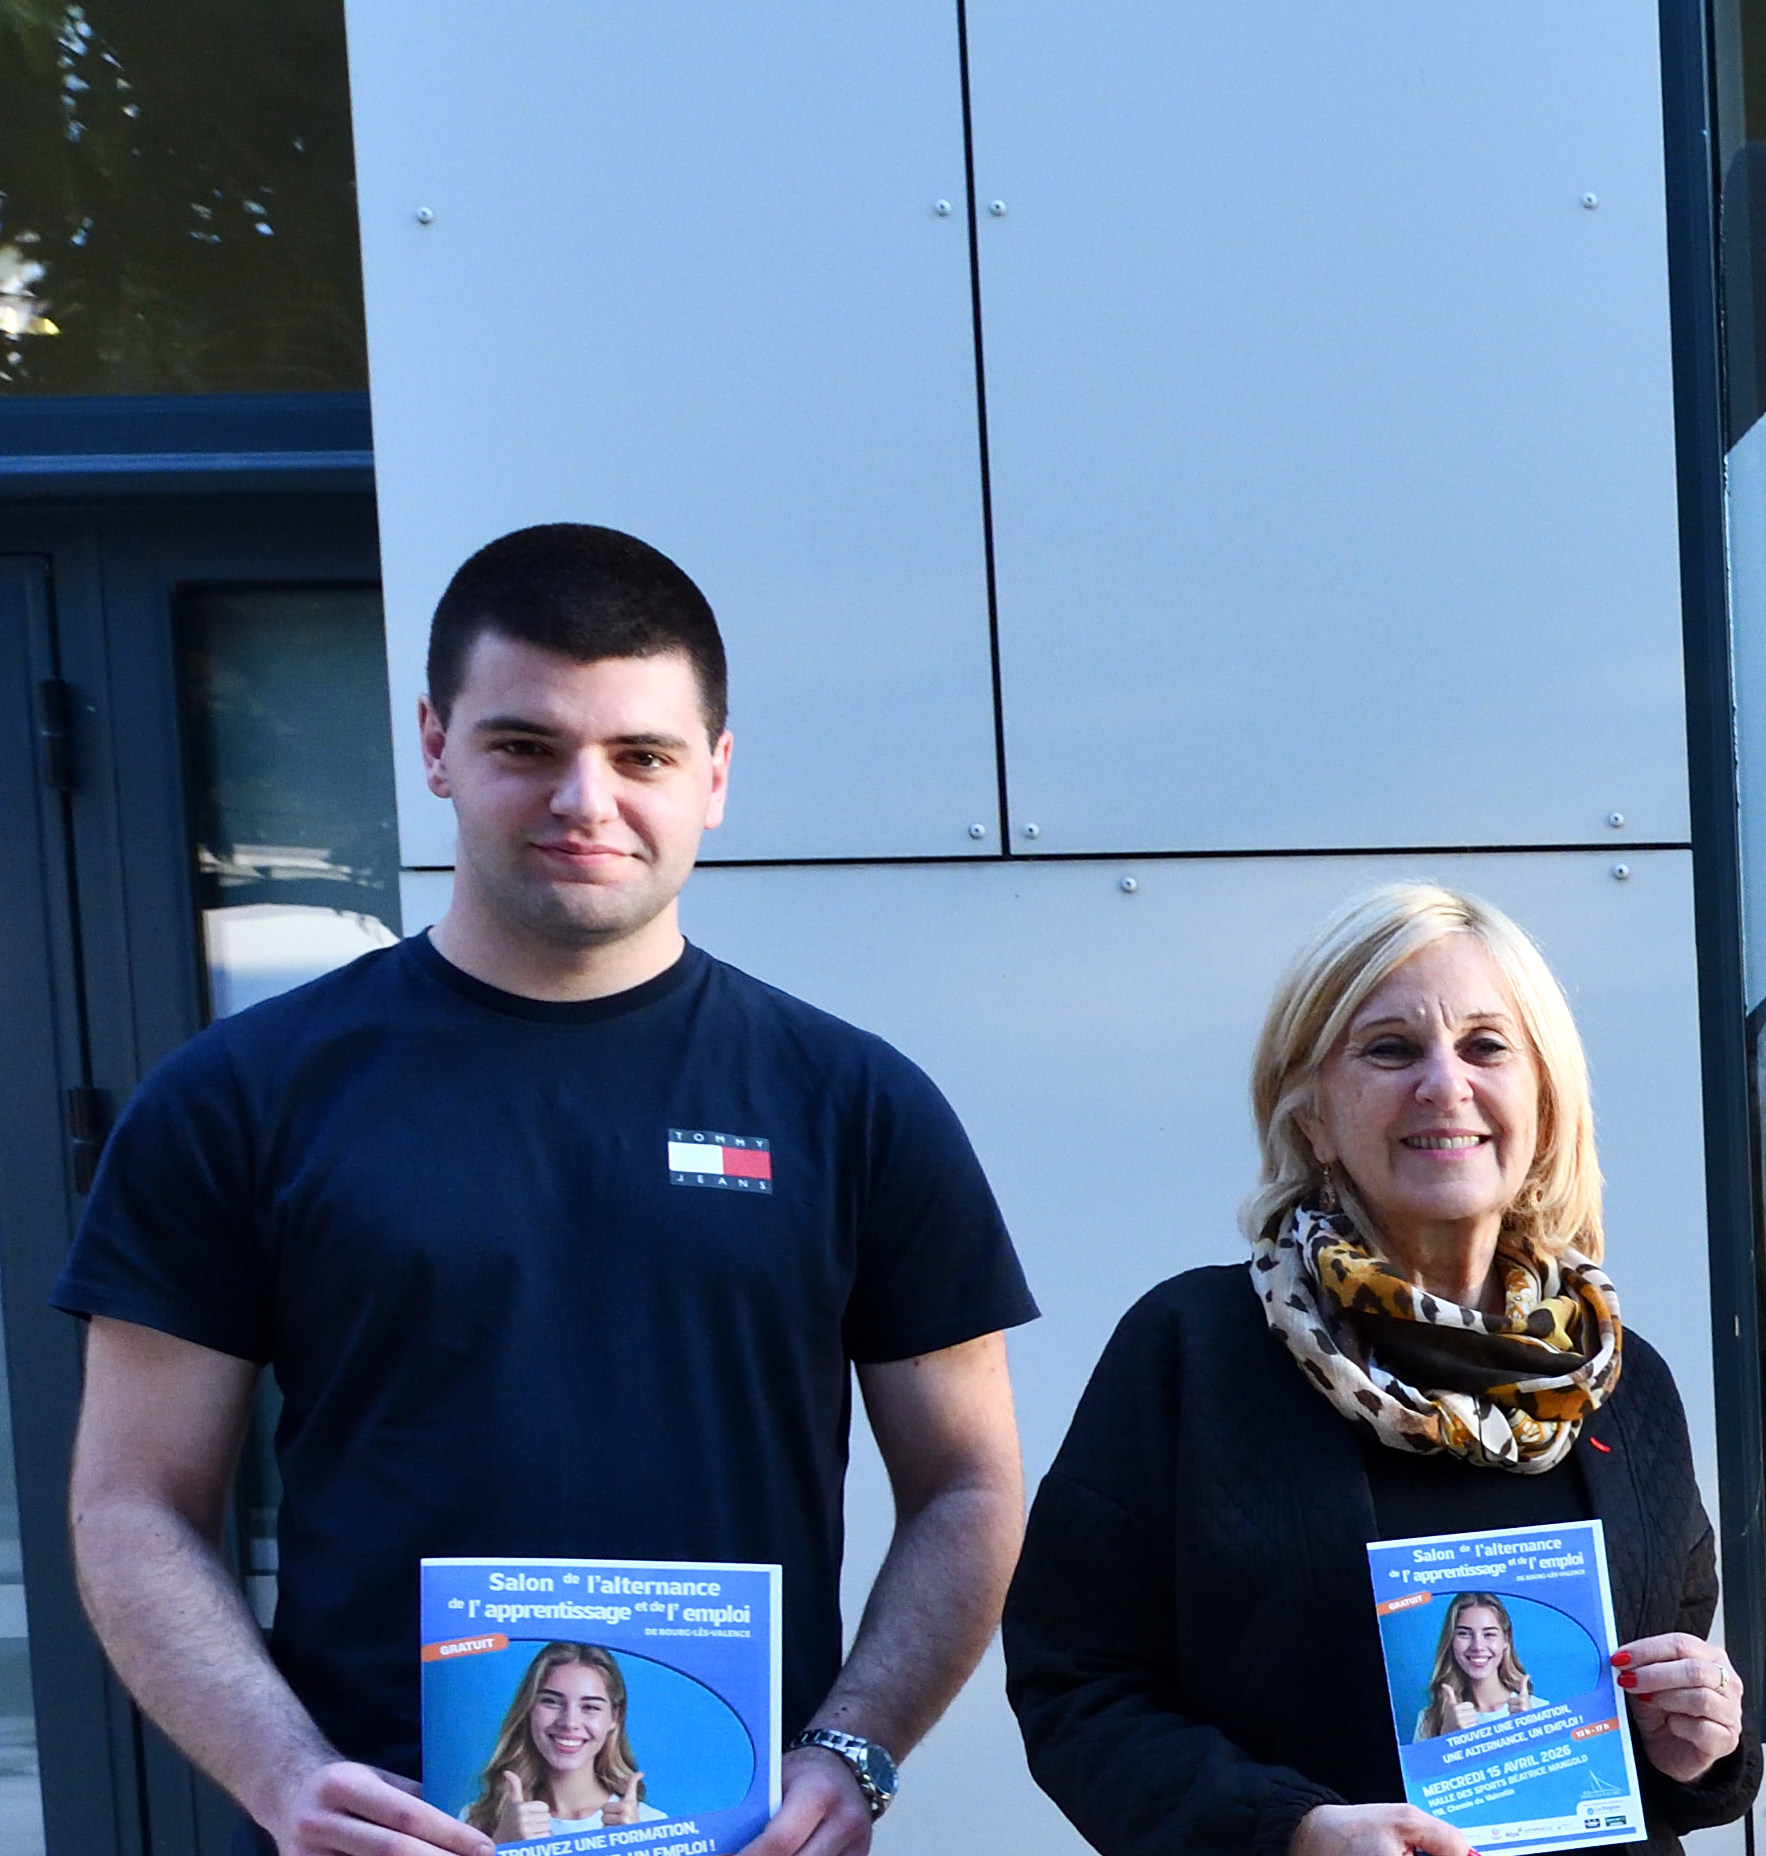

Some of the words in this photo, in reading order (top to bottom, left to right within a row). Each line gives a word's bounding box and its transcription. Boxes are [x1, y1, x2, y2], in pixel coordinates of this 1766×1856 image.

[675, 1131, 764, 1147] TOMMY
[677, 1174, 766, 1190] JEANS
[1412, 1547, 1455, 1563] Salon
[1474, 1538, 1561, 1558] l'alternance
[488, 1571, 554, 1592] Salon
[563, 1572, 580, 1584] de
[586, 1574, 720, 1596] l'alternance
[448, 1597, 464, 1609] de
[483, 1600, 631, 1624] apprentissage
[649, 1600, 665, 1612] de
[683, 1604, 750, 1626] emploi
[439, 1637, 495, 1656] GRATUIT
[1422, 1770, 1485, 1798] MERCREDI
[1486, 1765, 1501, 1778] 15
[1502, 1753, 1539, 1774] AVRIL
[1539, 1744, 1572, 1763] 2026
[574, 1835, 607, 1852] UNE
[609, 1820, 699, 1847] FORMATION,
